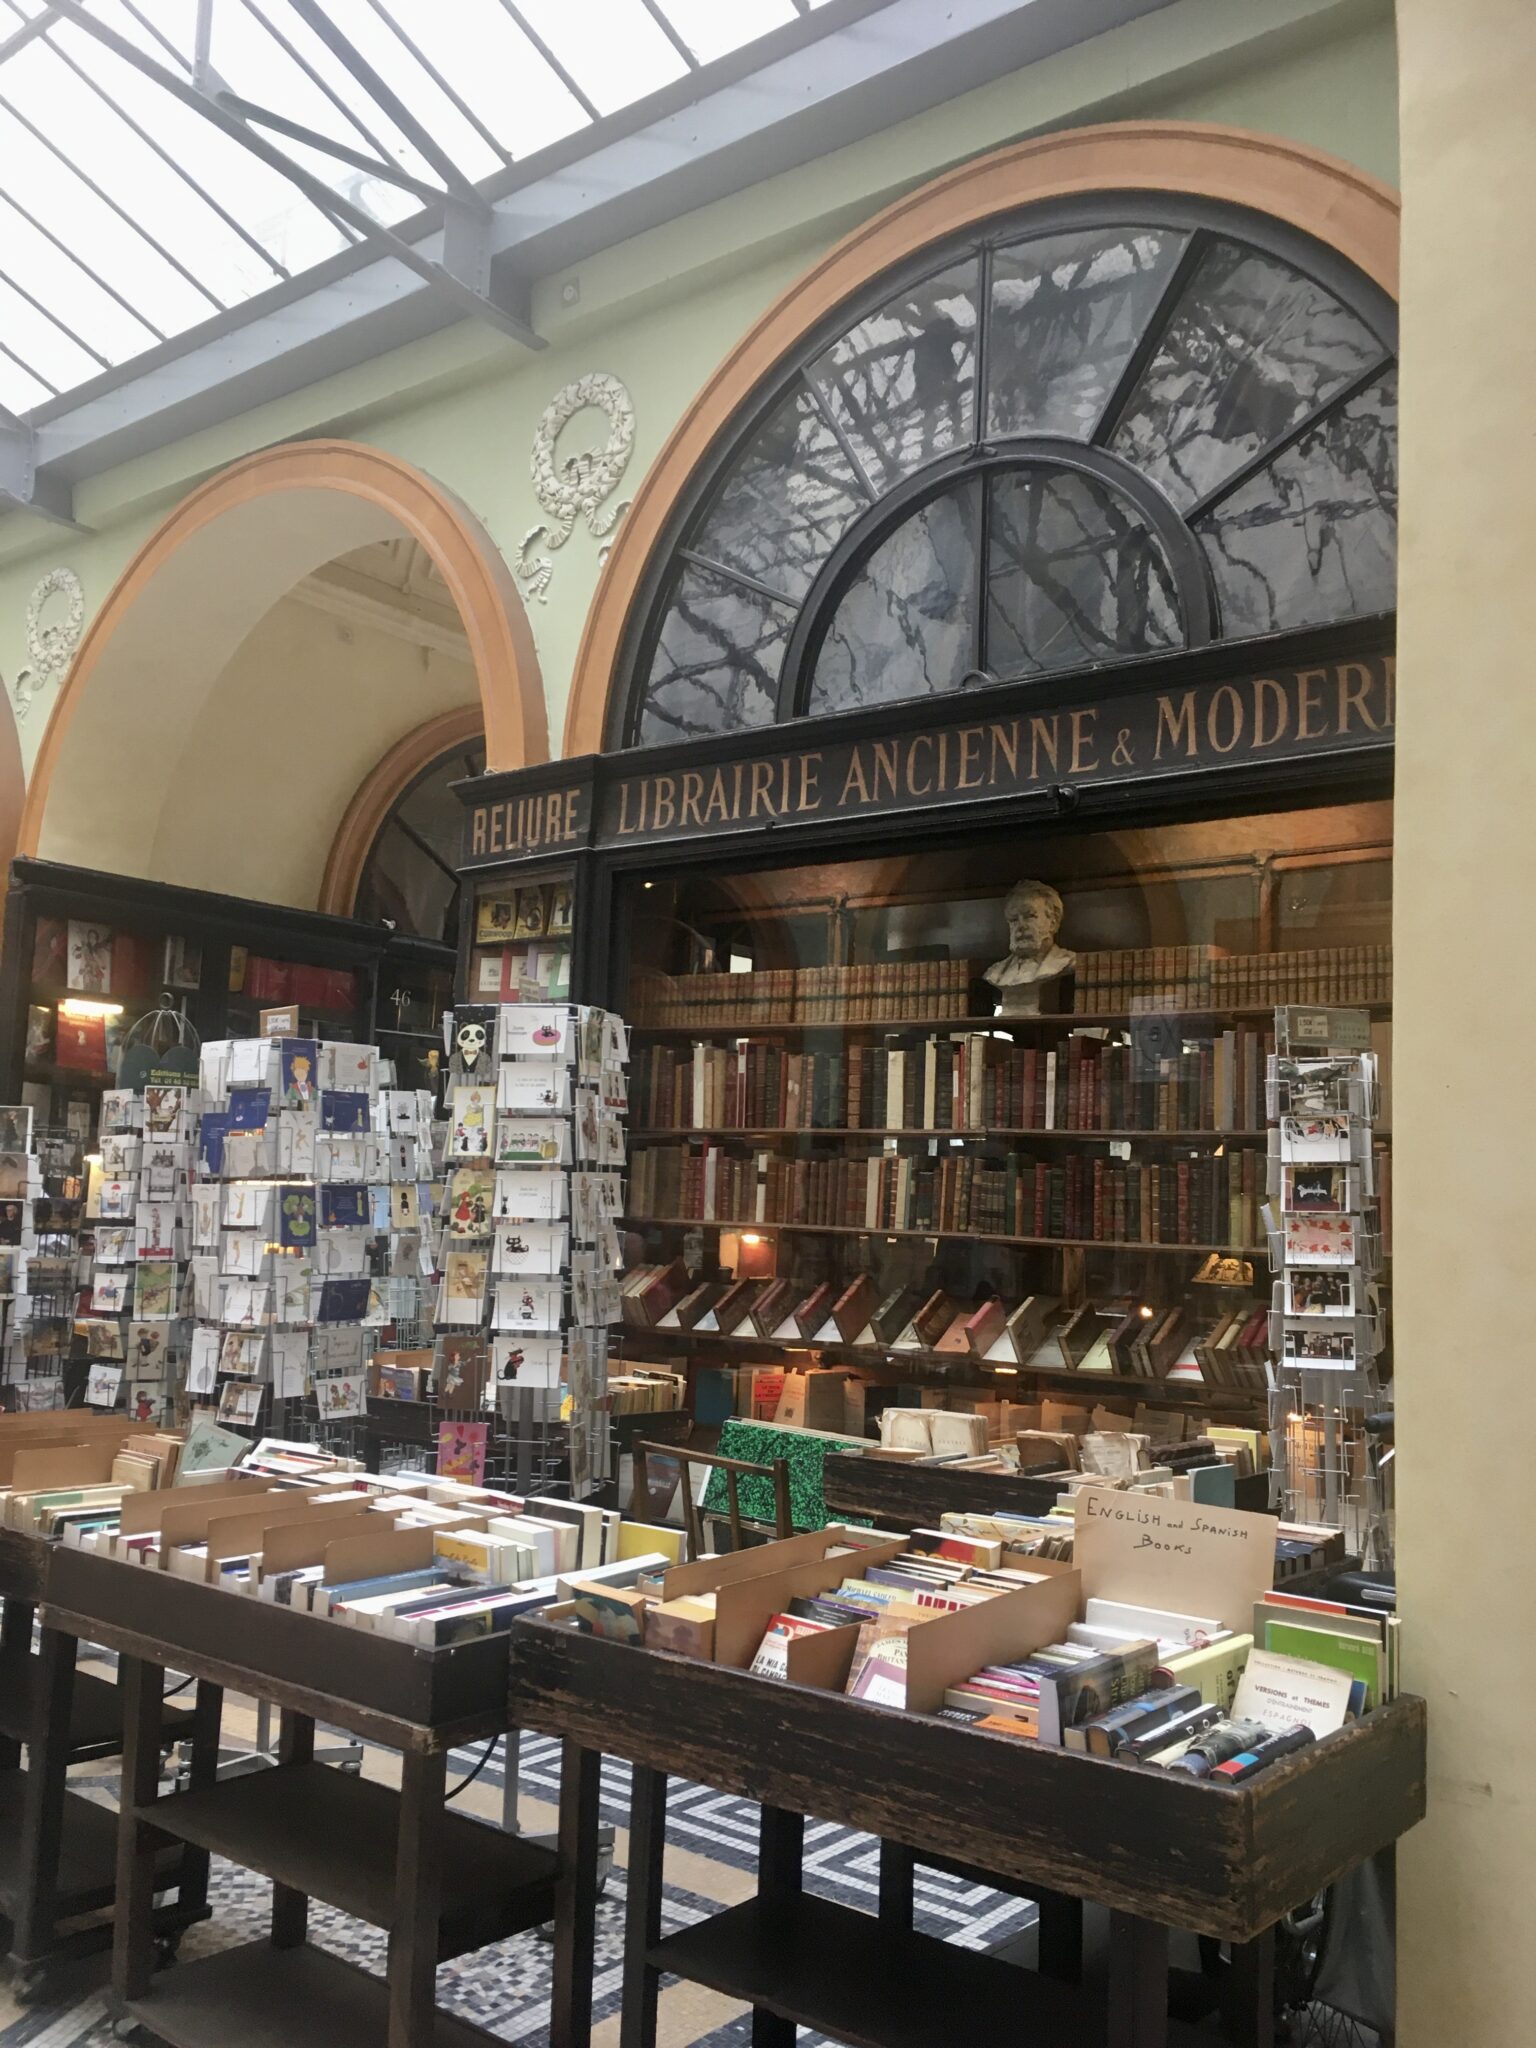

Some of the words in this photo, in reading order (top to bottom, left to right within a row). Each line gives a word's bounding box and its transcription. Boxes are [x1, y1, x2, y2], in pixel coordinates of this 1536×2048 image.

[617, 753, 824, 835] LIBRAIRIE
[838, 708, 1099, 805] ANCIENNE
[1111, 728, 1136, 767] &
[472, 788, 581, 856] RELIURE
[390, 988, 412, 1007] 46
[1167, 1520, 1184, 1530] and
[1254, 1684, 1288, 1699] VERSIONS
